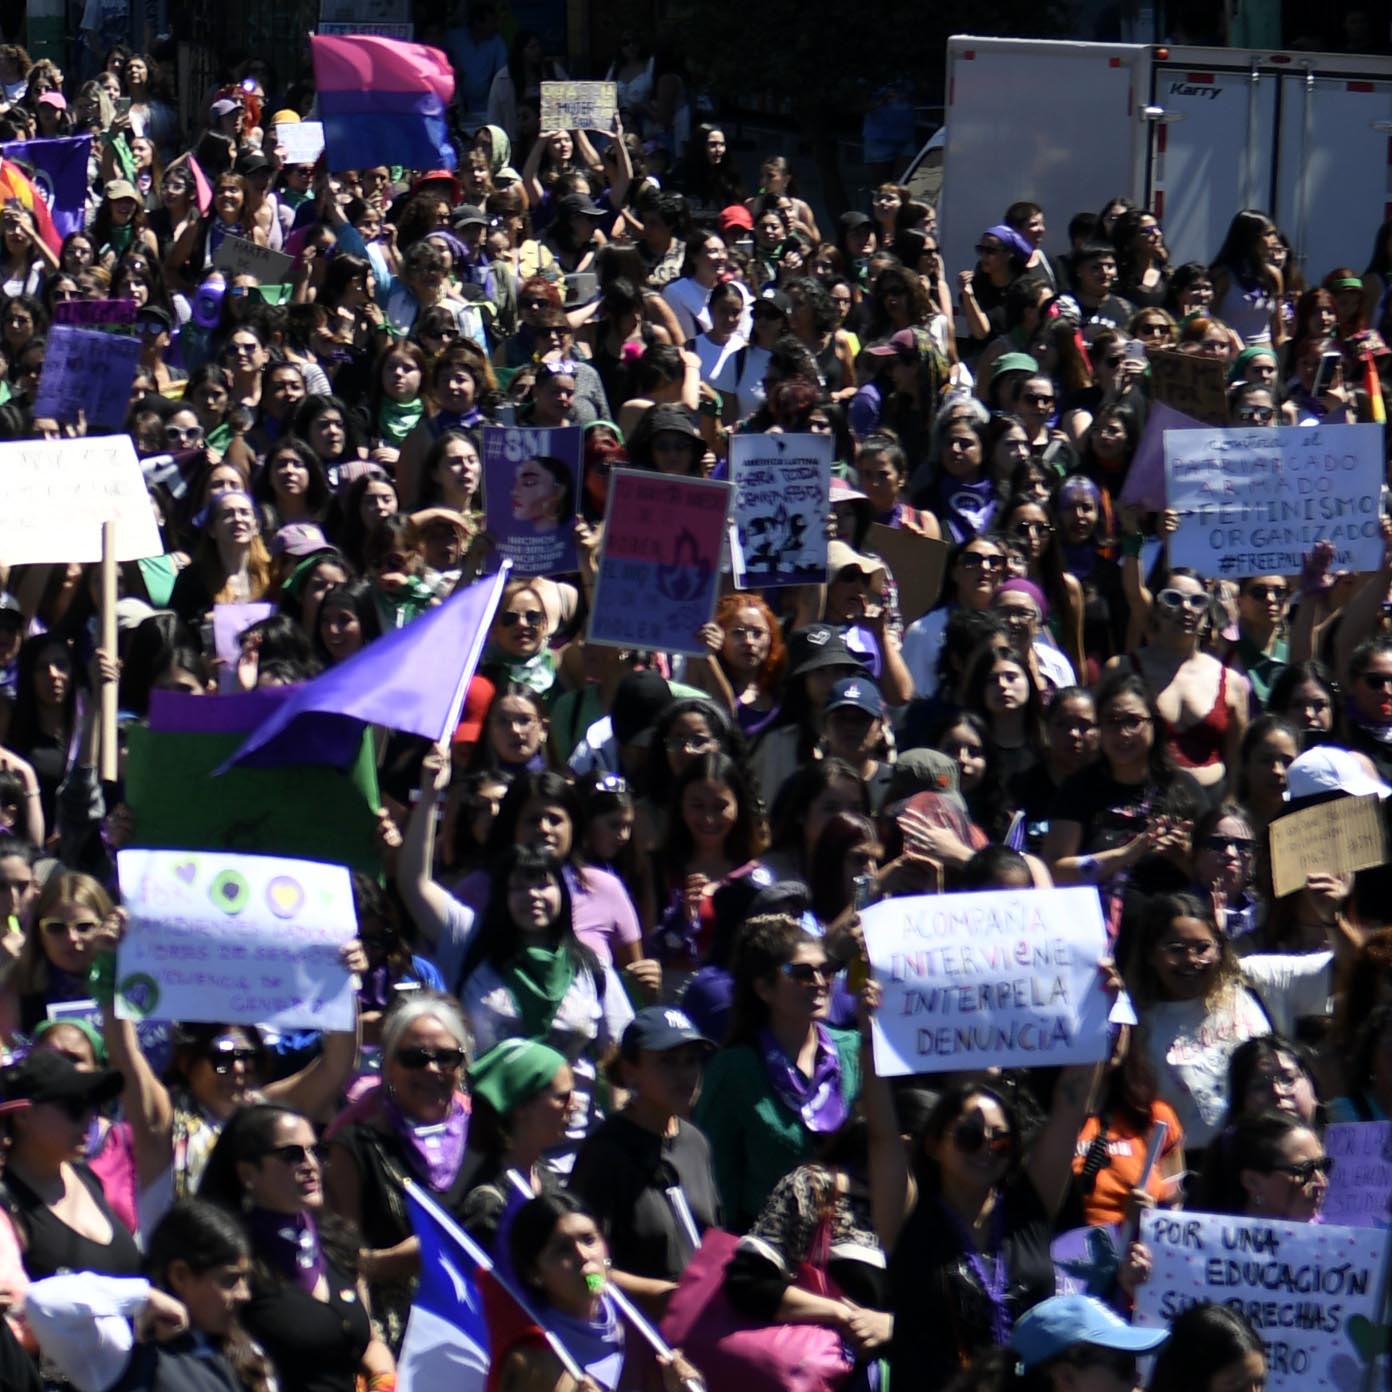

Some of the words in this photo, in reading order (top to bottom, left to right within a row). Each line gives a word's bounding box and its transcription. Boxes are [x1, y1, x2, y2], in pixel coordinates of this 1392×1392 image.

[1170, 82, 1224, 100] Karry
[1172, 455, 1357, 475] PATRIARCADO
[1200, 476, 1331, 496] ARMADO
[1198, 495, 1374, 526] FEMINISMO
[1209, 520, 1376, 550] ORGANIZADO
[1218, 550, 1353, 572] #FREEPALNA
[902, 901, 1047, 938] ACOMPAÑA
[902, 975, 1070, 1017] INTERPELA
[1153, 1217, 1204, 1250] POR
[1221, 1226, 1280, 1253] UNA
[1204, 1257, 1370, 1296] EDUCACIÓN
[1263, 1340, 1310, 1375] ERO
